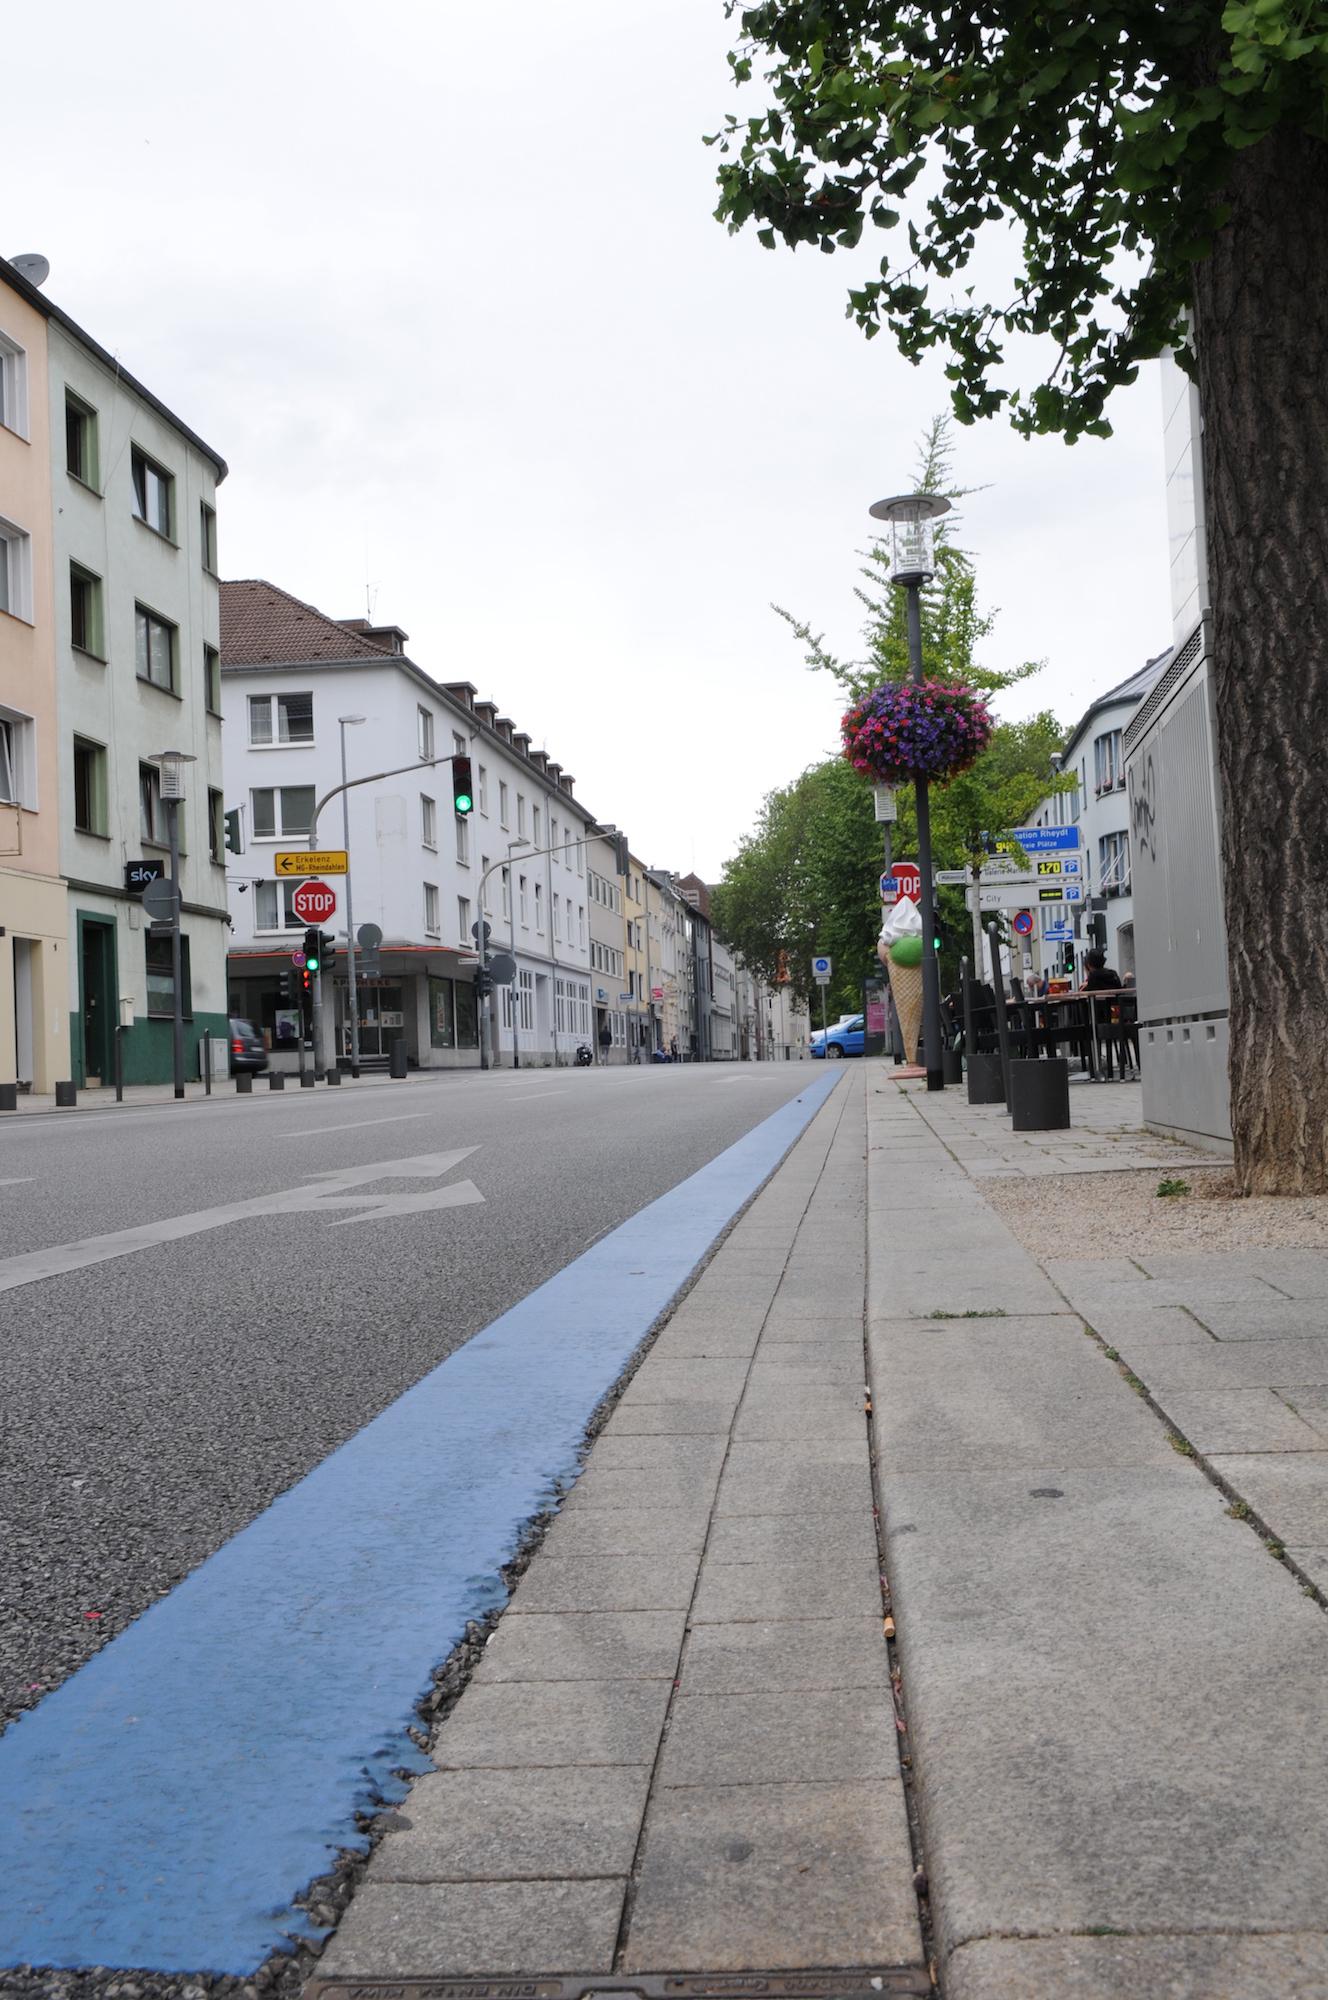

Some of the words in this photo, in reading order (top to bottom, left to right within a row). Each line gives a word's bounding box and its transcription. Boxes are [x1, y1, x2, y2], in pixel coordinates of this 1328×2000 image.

[131, 867, 158, 881] sky
[1039, 863, 1060, 874] 170
[894, 876, 920, 894] TOP
[297, 893, 334, 912] STOP
[986, 895, 1002, 903] City
